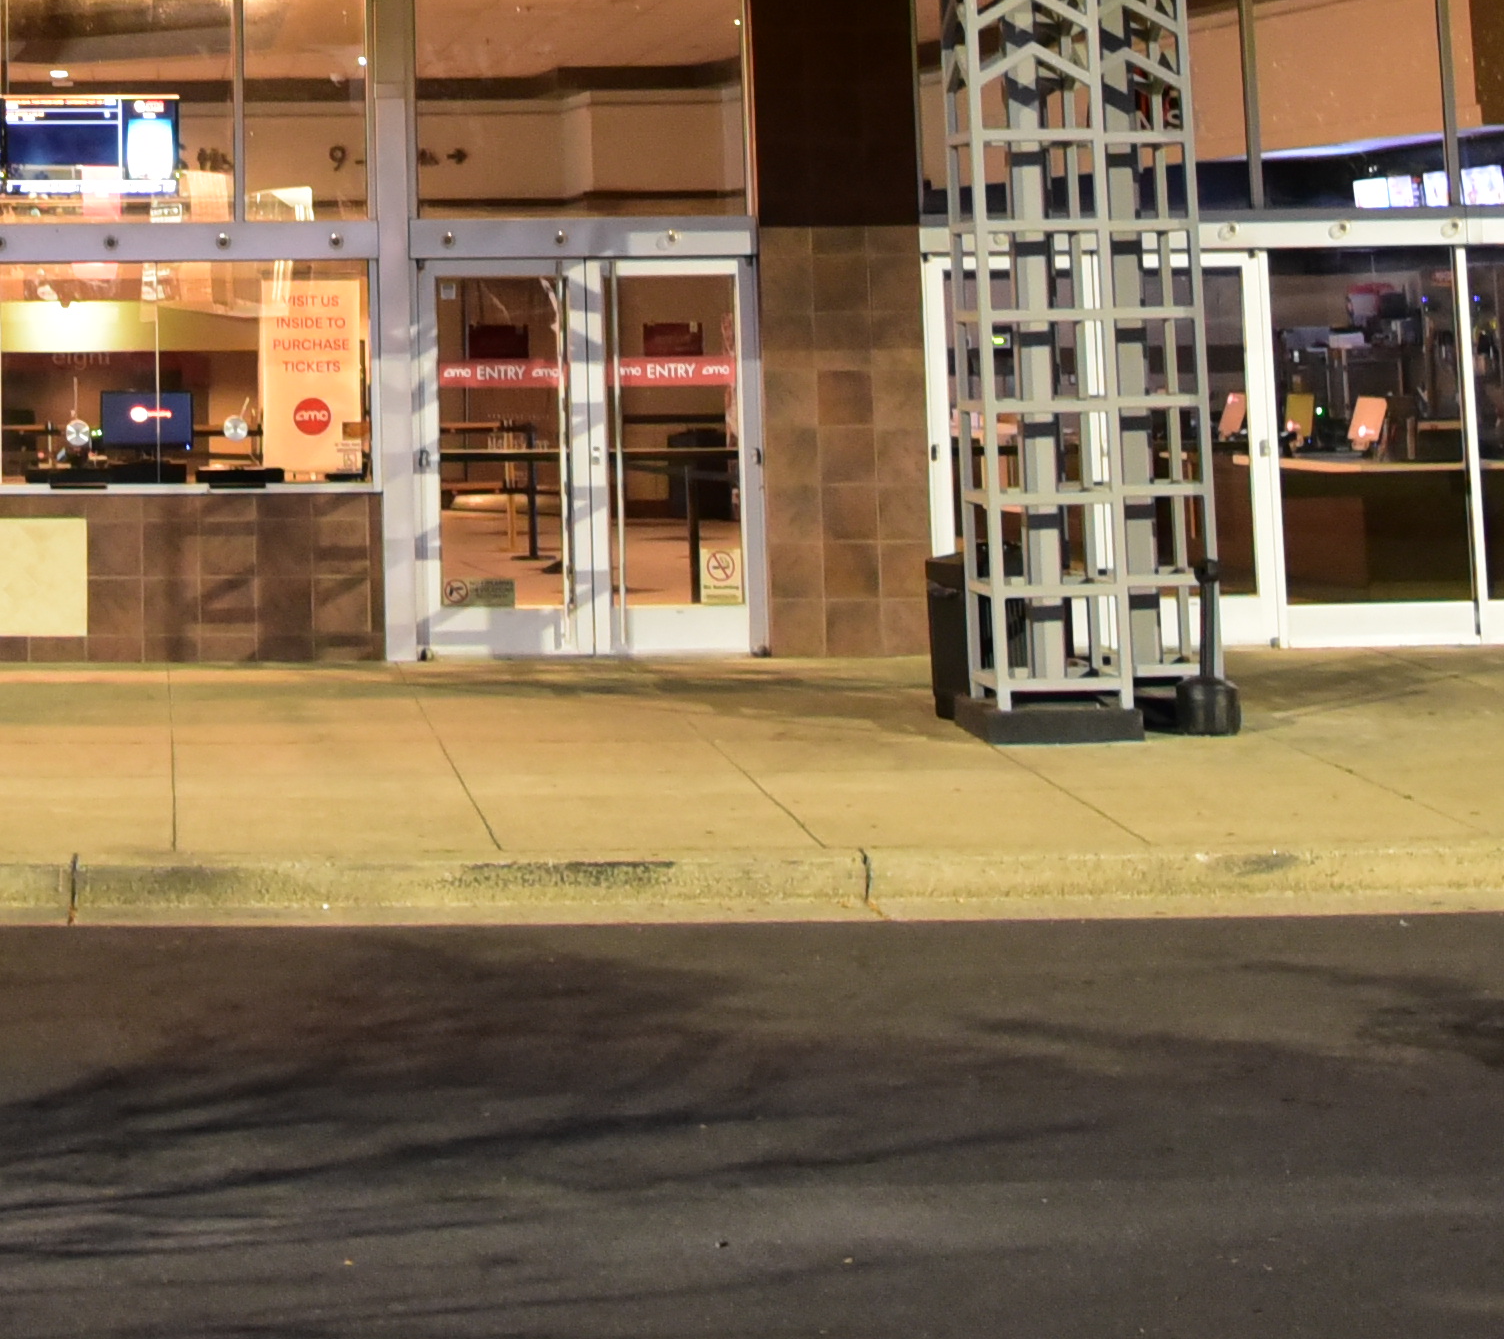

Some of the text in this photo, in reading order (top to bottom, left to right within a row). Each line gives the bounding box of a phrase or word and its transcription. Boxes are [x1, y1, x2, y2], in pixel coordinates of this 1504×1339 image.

[329, 145, 346, 172] 9
[282, 294, 339, 307] VISIT US
[276, 317, 346, 329] INSIDE TO
[273, 338, 349, 351] PURCHASE
[283, 360, 341, 373] TICKETS
[443, 365, 560, 380] amc ENTRY amc
[646, 363, 696, 378] ENTRY
[702, 365, 730, 375] amc
[295, 409, 329, 421] amc
